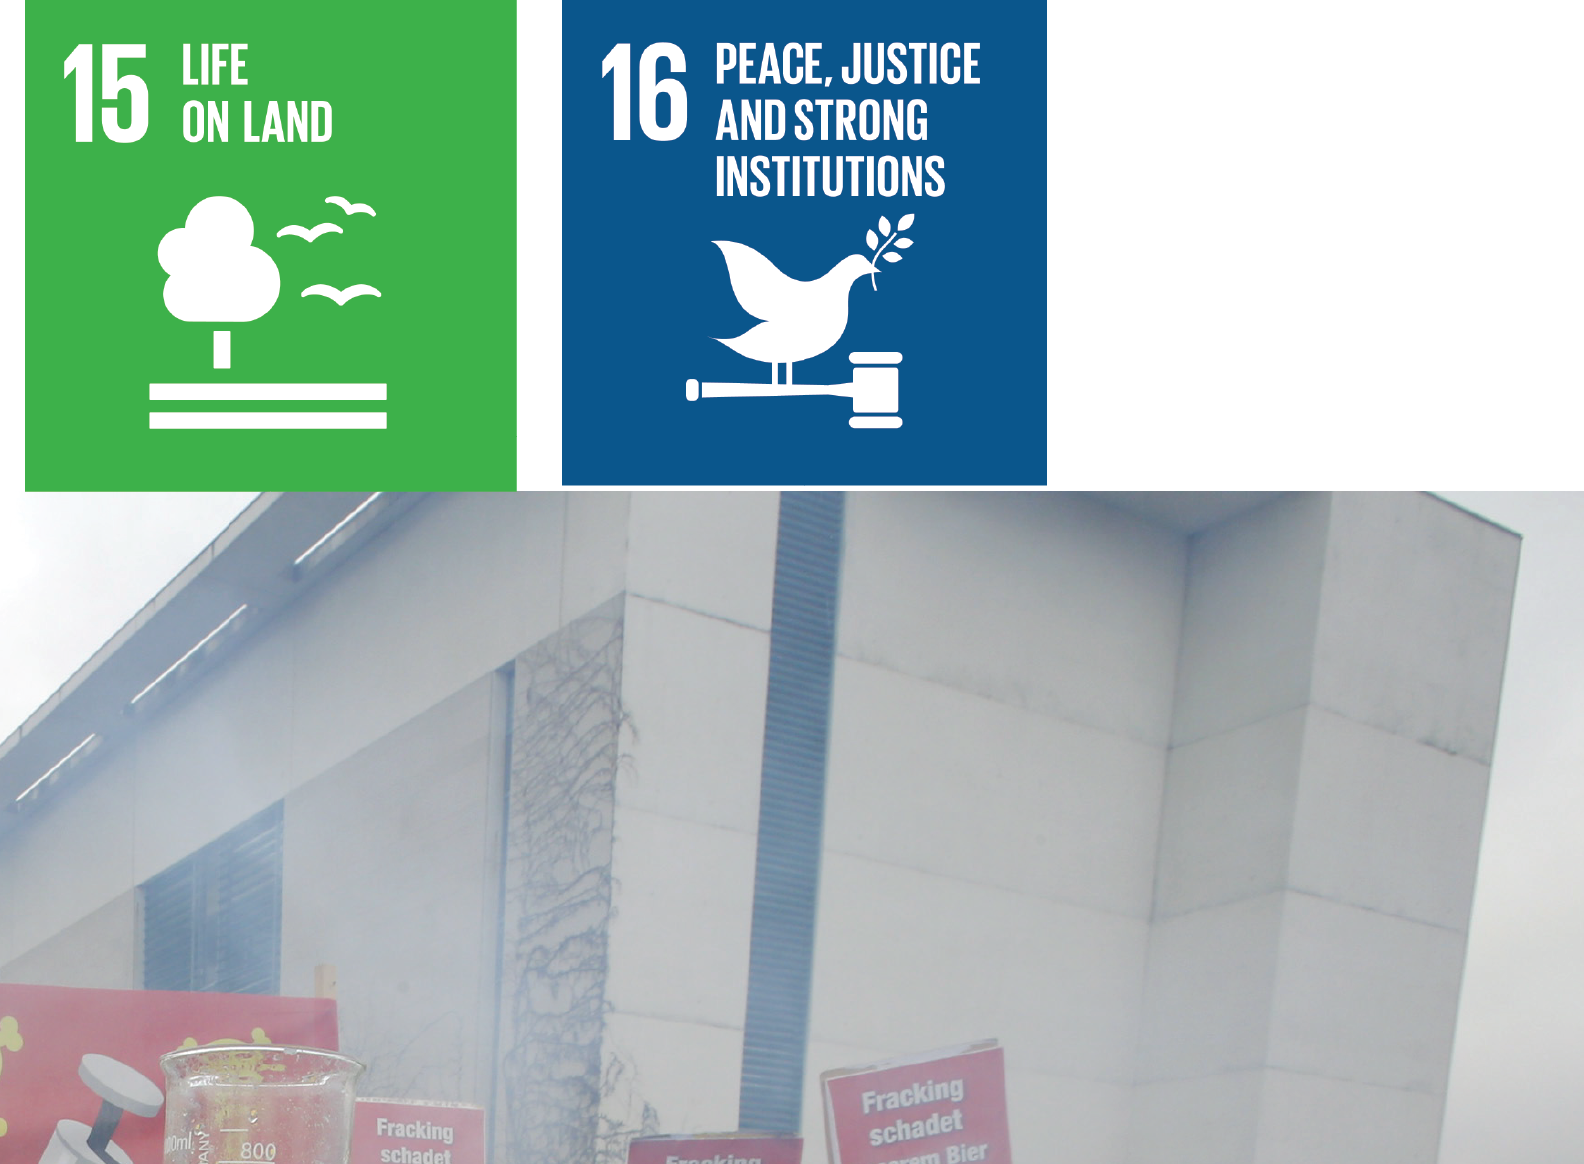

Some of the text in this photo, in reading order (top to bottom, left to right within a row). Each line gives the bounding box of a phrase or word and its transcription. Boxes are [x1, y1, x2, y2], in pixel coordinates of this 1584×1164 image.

[862, 1078, 965, 1115] Fracking
[376, 1117, 454, 1145] Fracking
[869, 1108, 964, 1147] schadet
[240, 1142, 277, 1160] 800
